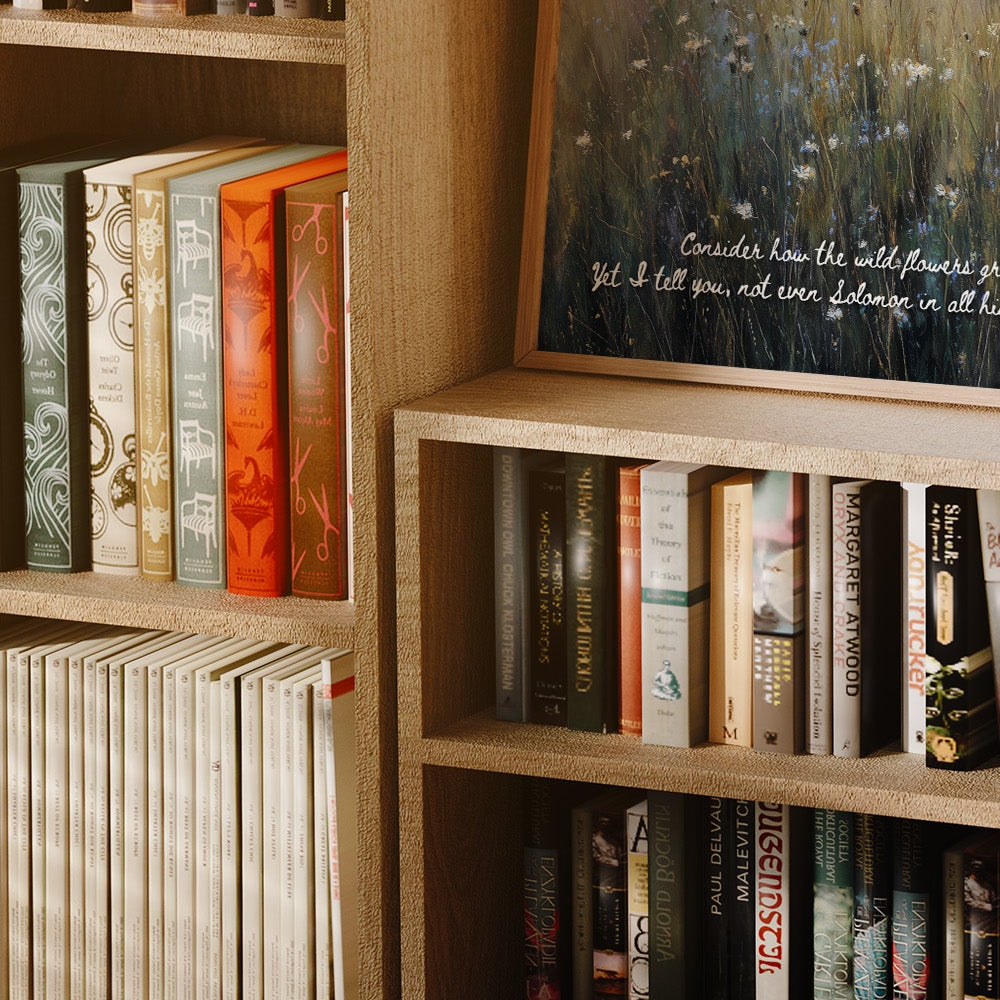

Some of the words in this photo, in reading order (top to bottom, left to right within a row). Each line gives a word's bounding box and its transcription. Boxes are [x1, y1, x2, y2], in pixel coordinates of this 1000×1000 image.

[680, 232, 765, 259] Consider
[769, 238, 810, 262] how
[815, 240, 847, 268] the
[591, 261, 621, 292] Yet
[629, 260, 649, 288] I
[653, 267, 685, 292] tell
[692, 275, 731, 300] you,
[737, 278, 771, 300] not
[778, 287, 821, 303] even
[830, 280, 913, 308] Solomon
[919, 291, 941, 312] in
[948, 288, 974, 314] all
[502, 455, 512, 529] DOWNTOWN
[834, 492, 846, 543] ORYX
[502, 531, 512, 558] OWL
[651, 537, 682, 551] Theory
[845, 493, 860, 606] MARGARET
[502, 564, 513, 606] CHUCK
[834, 548, 846, 593] AND
[502, 610, 513, 690] KLOSTERMAN
[834, 596, 846, 669] CRAKE
[845, 612, 860, 697] ATWOOD
[711, 797, 723, 865] DELVAU
[710, 871, 722, 916] PAUL
